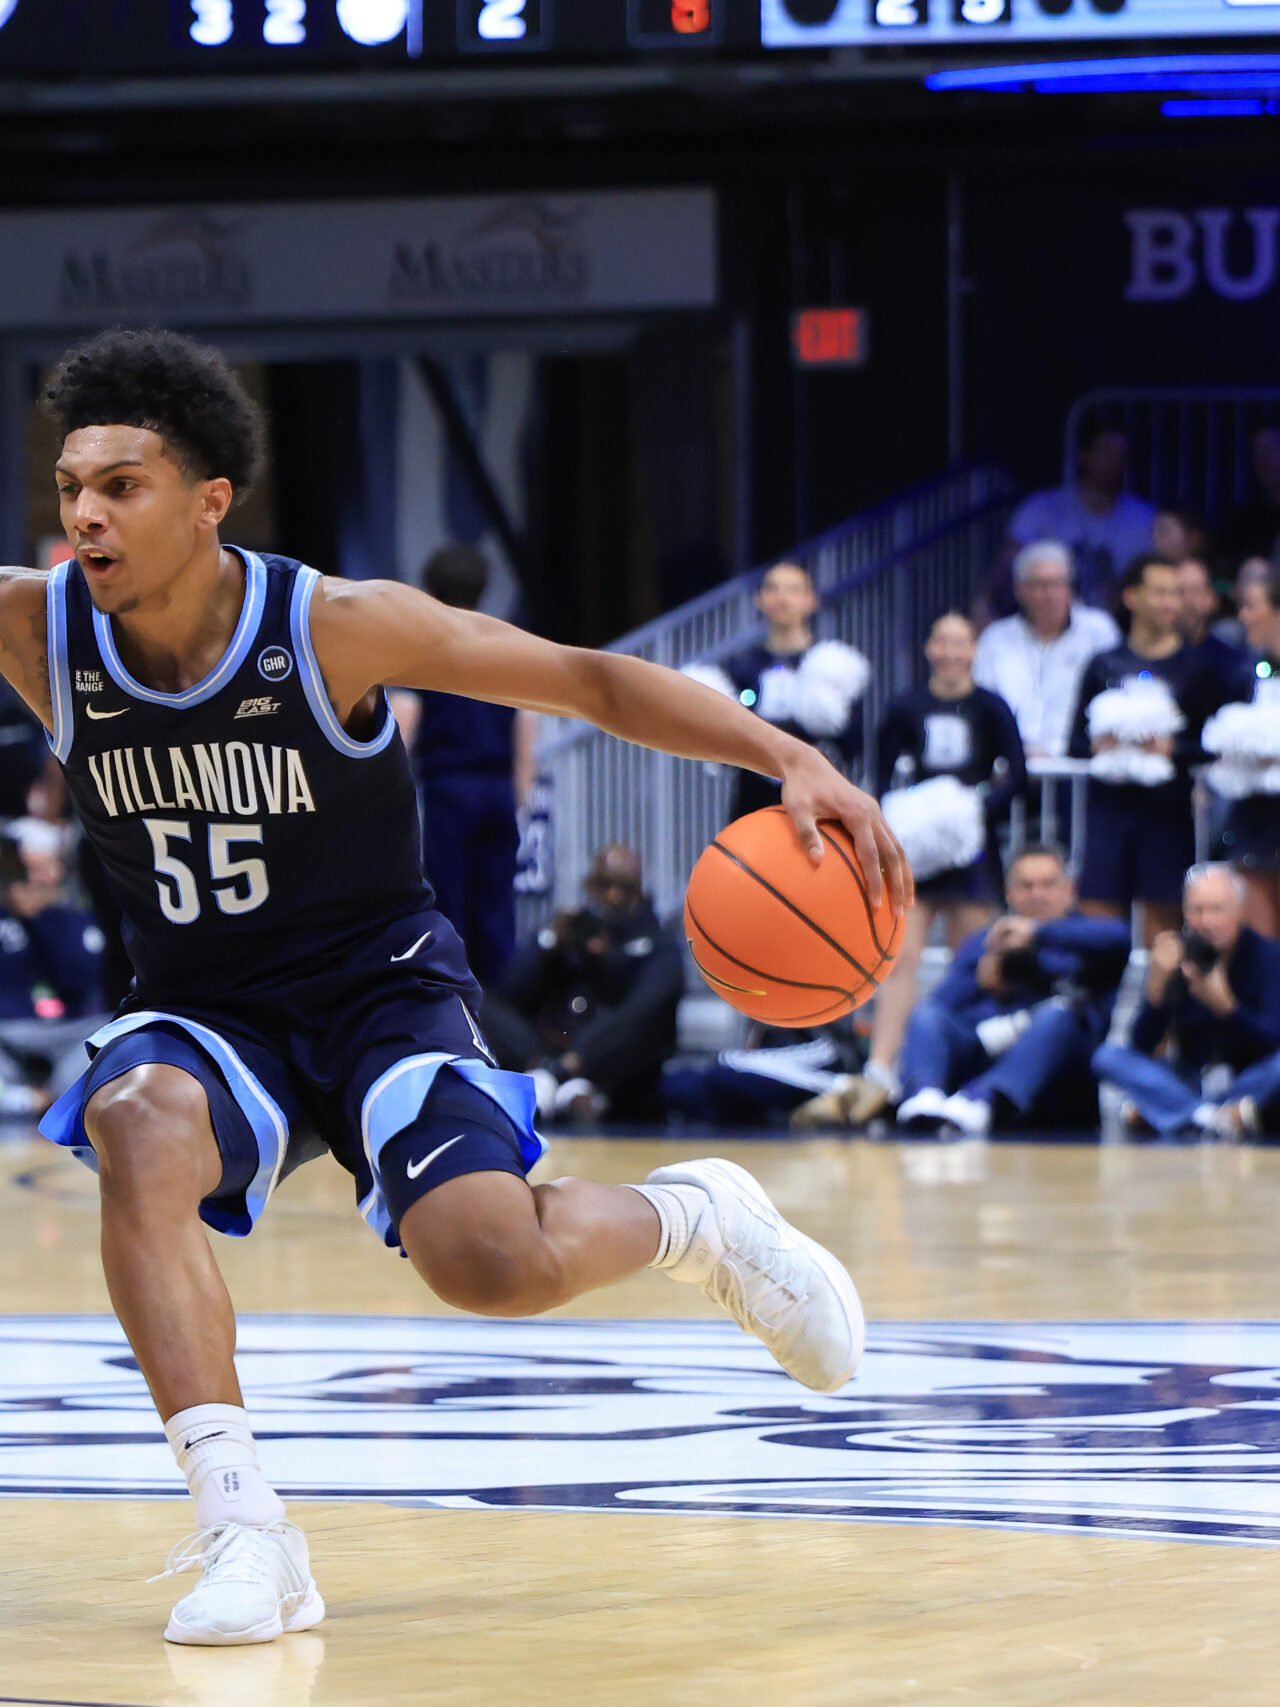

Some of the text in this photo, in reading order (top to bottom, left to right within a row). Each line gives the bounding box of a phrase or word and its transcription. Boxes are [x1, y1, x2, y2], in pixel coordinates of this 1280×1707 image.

[263, 655, 286, 672] GHR
[83, 671, 101, 682] THE
[236, 703, 281, 715] EAST
[240, 697, 272, 707] BIG
[88, 741, 316, 817] VILLANOVA
[142, 818, 269, 925] 55
